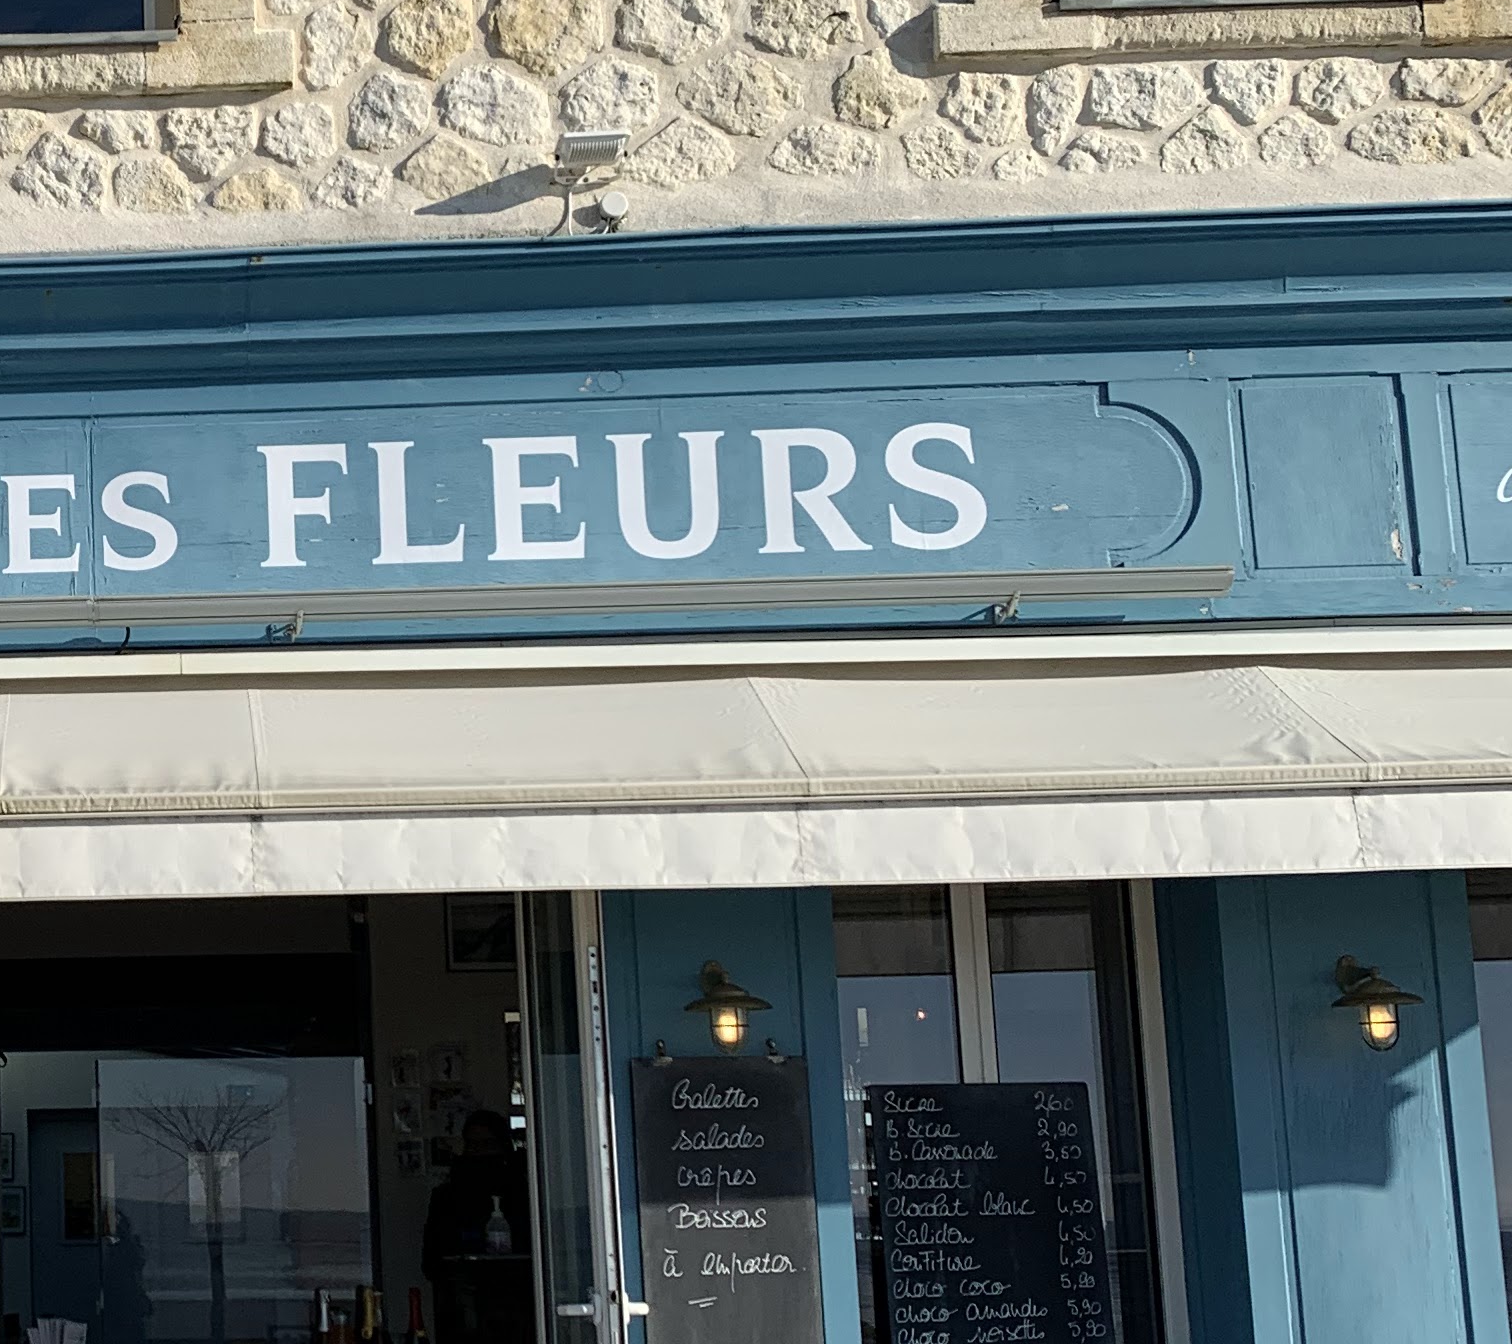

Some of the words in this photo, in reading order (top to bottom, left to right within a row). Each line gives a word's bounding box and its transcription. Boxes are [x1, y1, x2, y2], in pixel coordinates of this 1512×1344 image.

[256, 422, 990, 568] FLEURS
[667, 1203, 768, 1229] Boissons
[979, 1191, 1036, 1215] blanc
